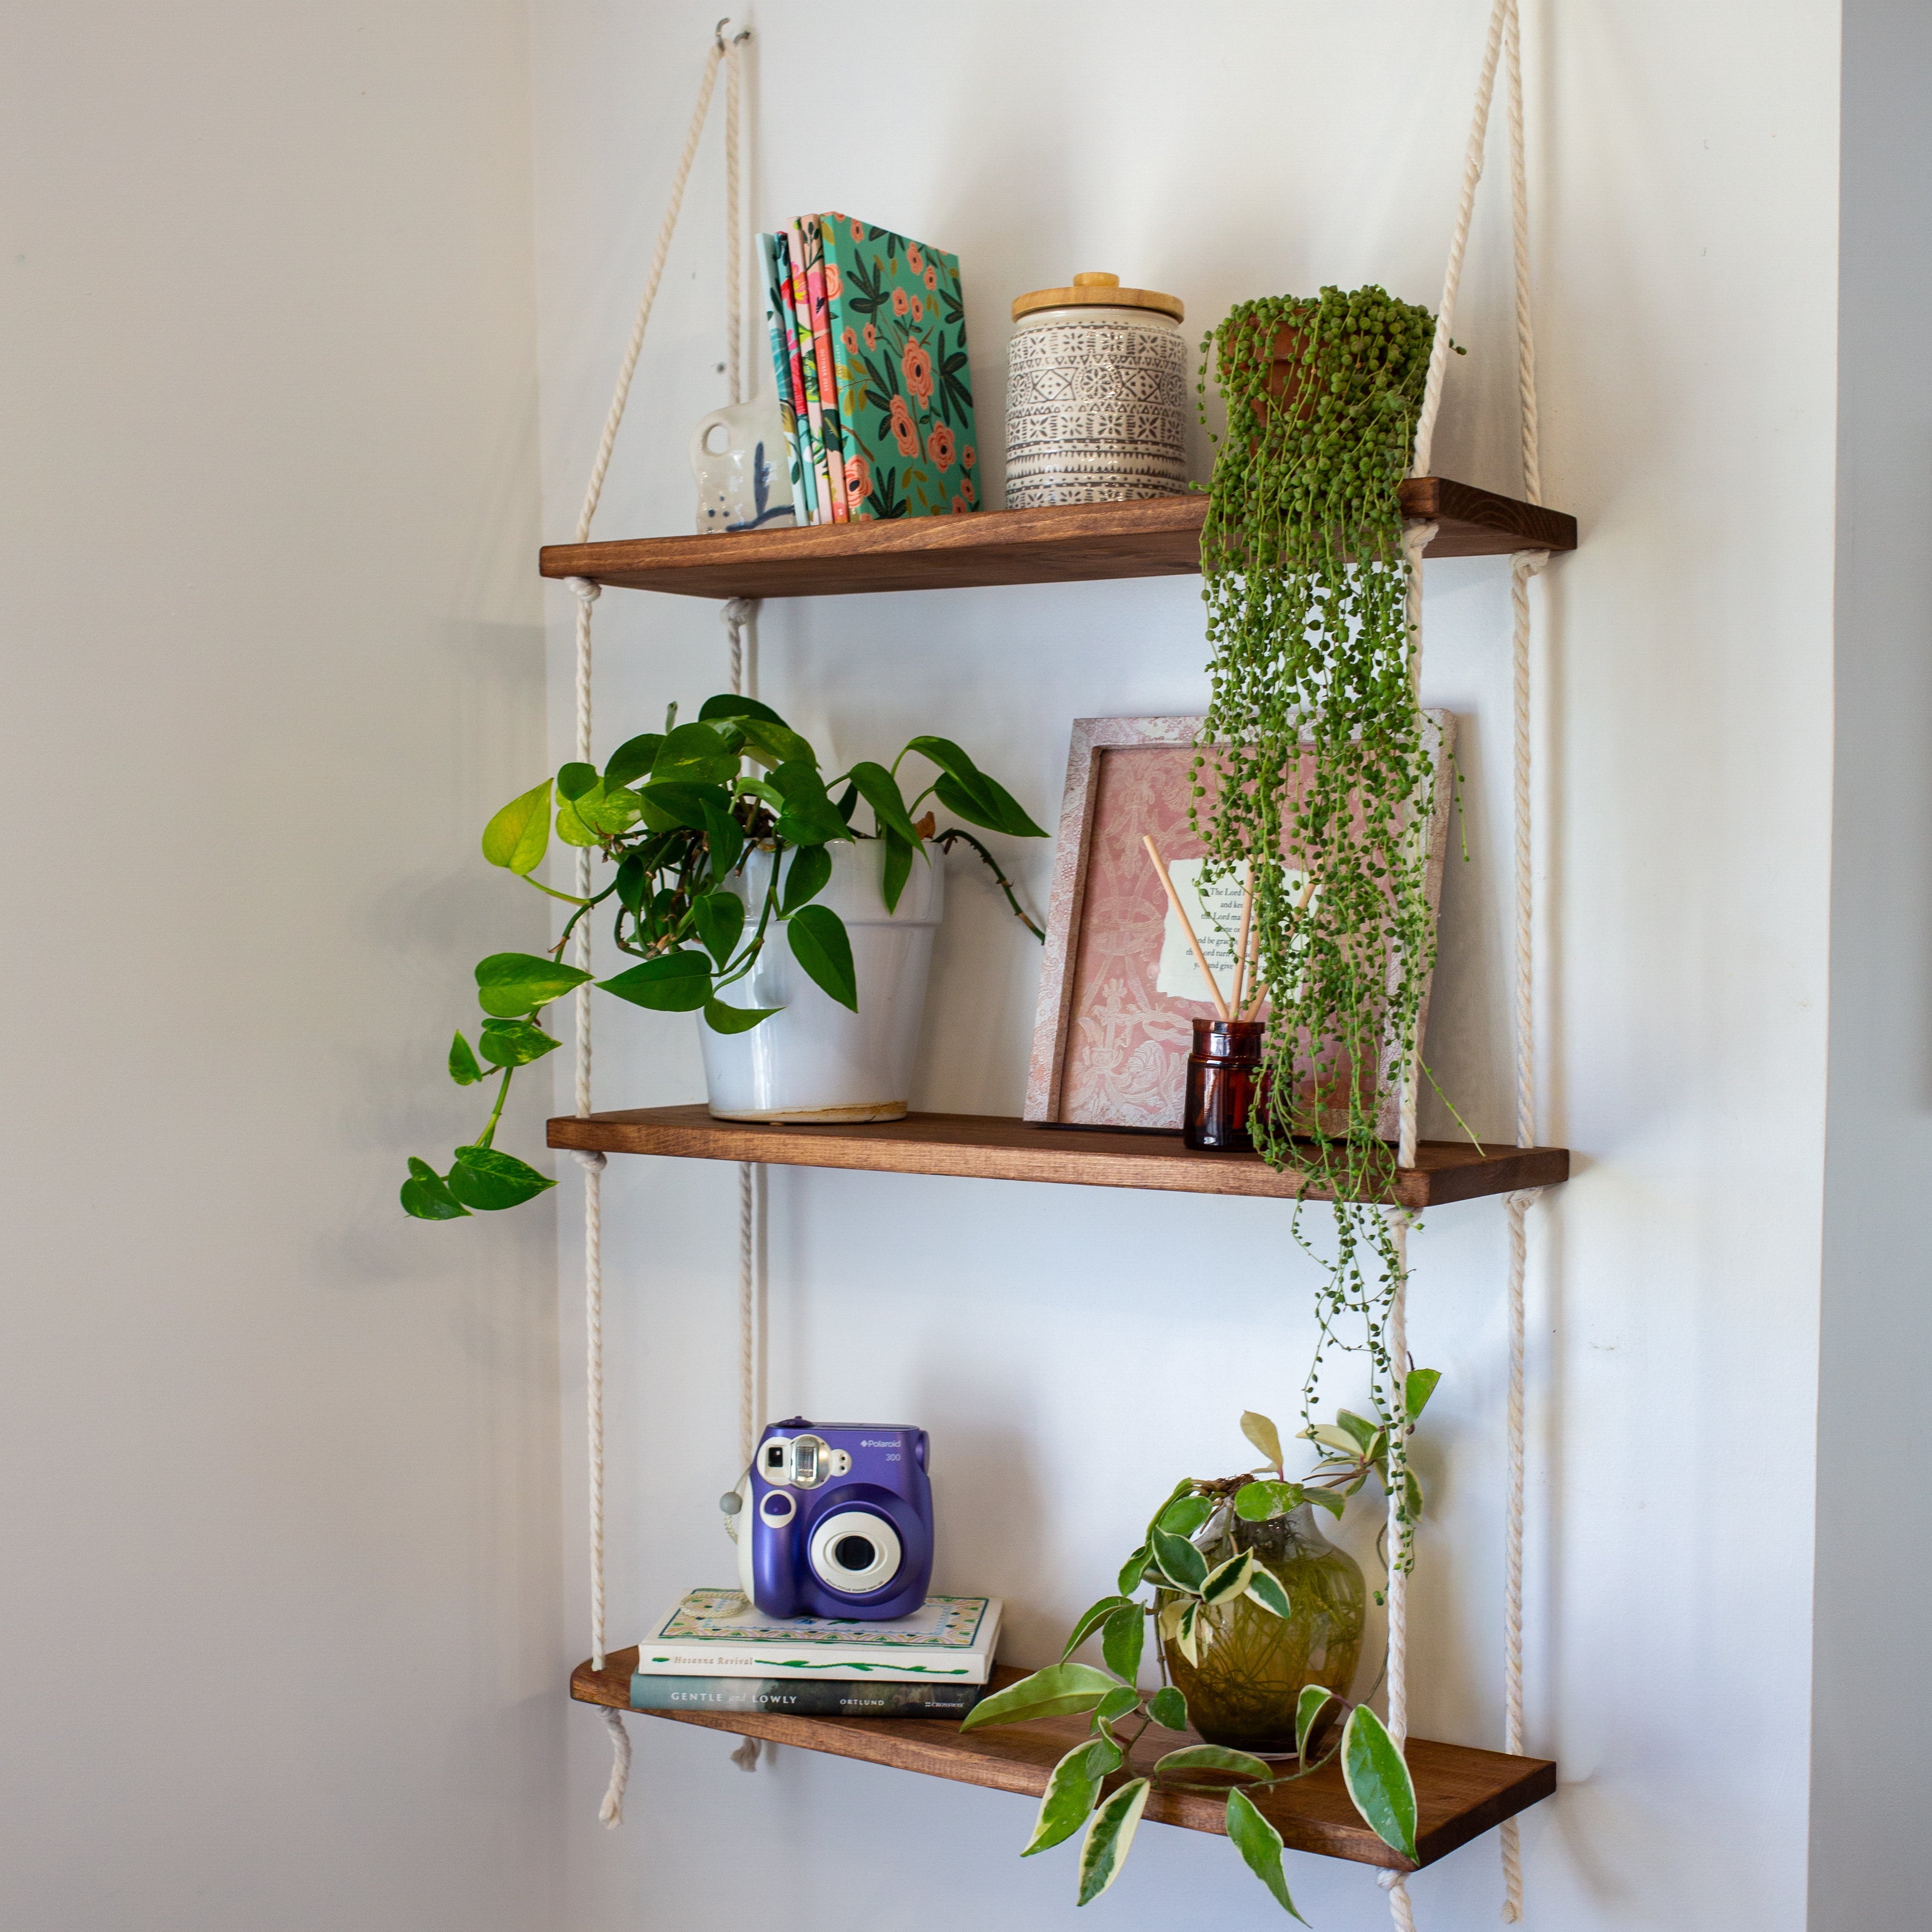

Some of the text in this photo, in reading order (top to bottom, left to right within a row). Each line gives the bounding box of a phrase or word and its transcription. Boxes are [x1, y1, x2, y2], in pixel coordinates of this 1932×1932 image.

[1225, 888, 1241, 896] Lord
[1208, 936, 1216, 944] be
[1219, 962, 1234, 971] give
[885, 1453, 901, 1461] 300
[674, 1656, 714, 1664] Hosanna
[670, 1692, 723, 1702] GENTLE
[728, 1693, 746, 1702] and
[752, 1694, 797, 1704] LOWLY
